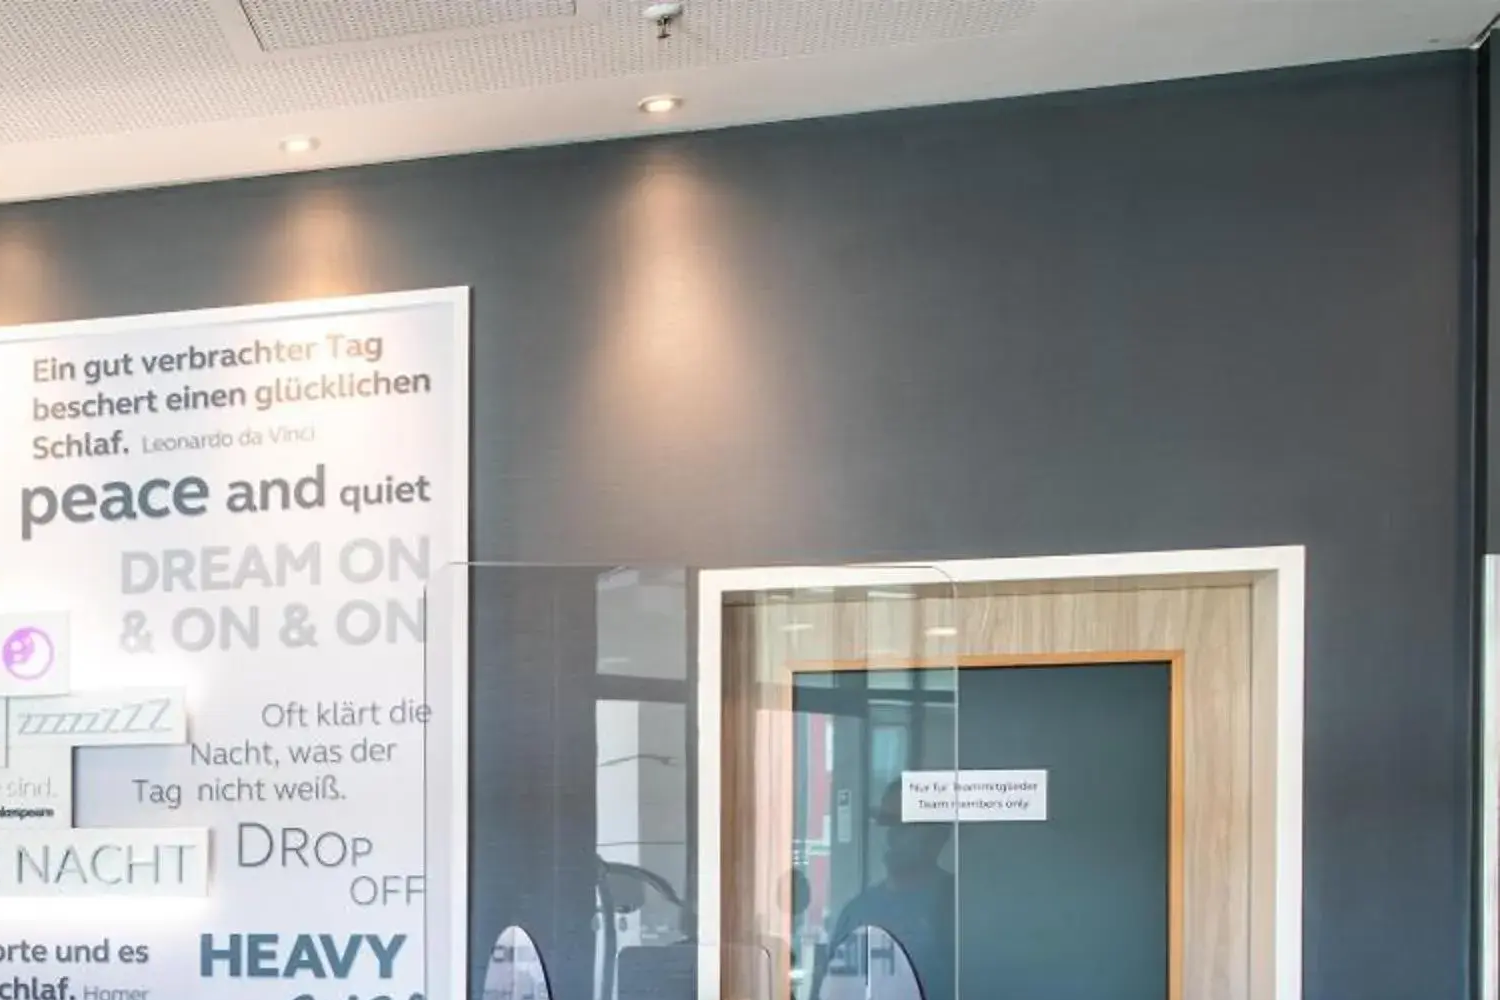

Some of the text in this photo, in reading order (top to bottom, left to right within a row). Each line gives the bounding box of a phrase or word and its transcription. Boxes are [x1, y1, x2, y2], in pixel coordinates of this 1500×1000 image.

[33, 332, 383, 386] Ein gut verbrachter Tag
[32, 370, 431, 422] beschert einen glücklichen
[32, 431, 130, 460] Schlaf.
[142, 423, 315, 455] Leonardo da Vinci
[21, 464, 431, 540] peace and quiet
[121, 536, 431, 595] DREAM ON
[119, 597, 426, 654] & ON & ON
[261, 698, 432, 729] Oft klärt die
[190, 738, 397, 767] Nacht, was der
[6, 777, 59, 800] sind.
[132, 774, 348, 809] Tag nicht weiß.
[17, 844, 197, 886] NACHT
[349, 874, 427, 907] OFF
[55, 938, 110, 964] und
[118, 943, 150, 964] es
[200, 933, 408, 979] HEAVY
